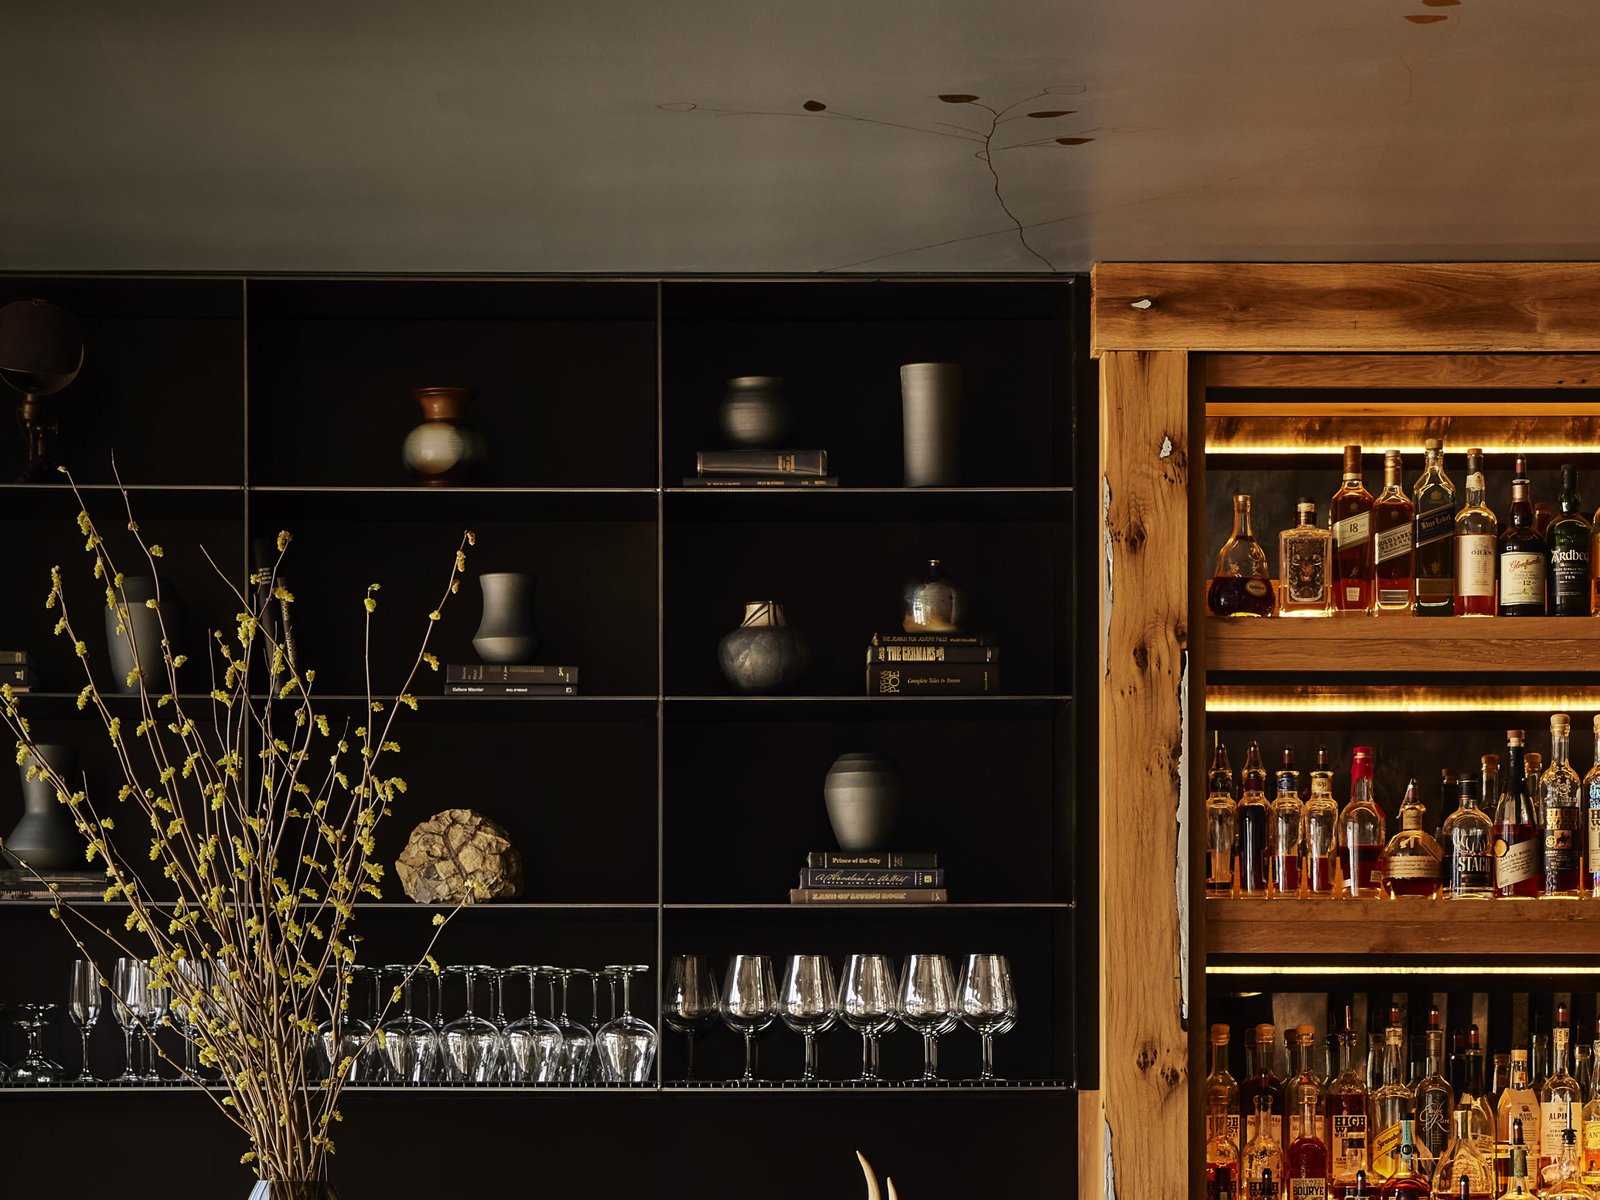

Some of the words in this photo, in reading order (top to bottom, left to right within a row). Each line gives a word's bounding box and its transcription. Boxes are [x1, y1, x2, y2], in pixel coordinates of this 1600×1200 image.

[1350, 523, 1359, 533] 18
[887, 646, 901, 661] THE
[902, 646, 936, 661] GERMANS
[890, 670, 900, 693] POE
[832, 857, 851, 865] Prince
[859, 857, 868, 865] the
[869, 857, 881, 866] City
[1334, 1116, 1366, 1127] HIGH
[1293, 1186, 1324, 1196] BOURYE
